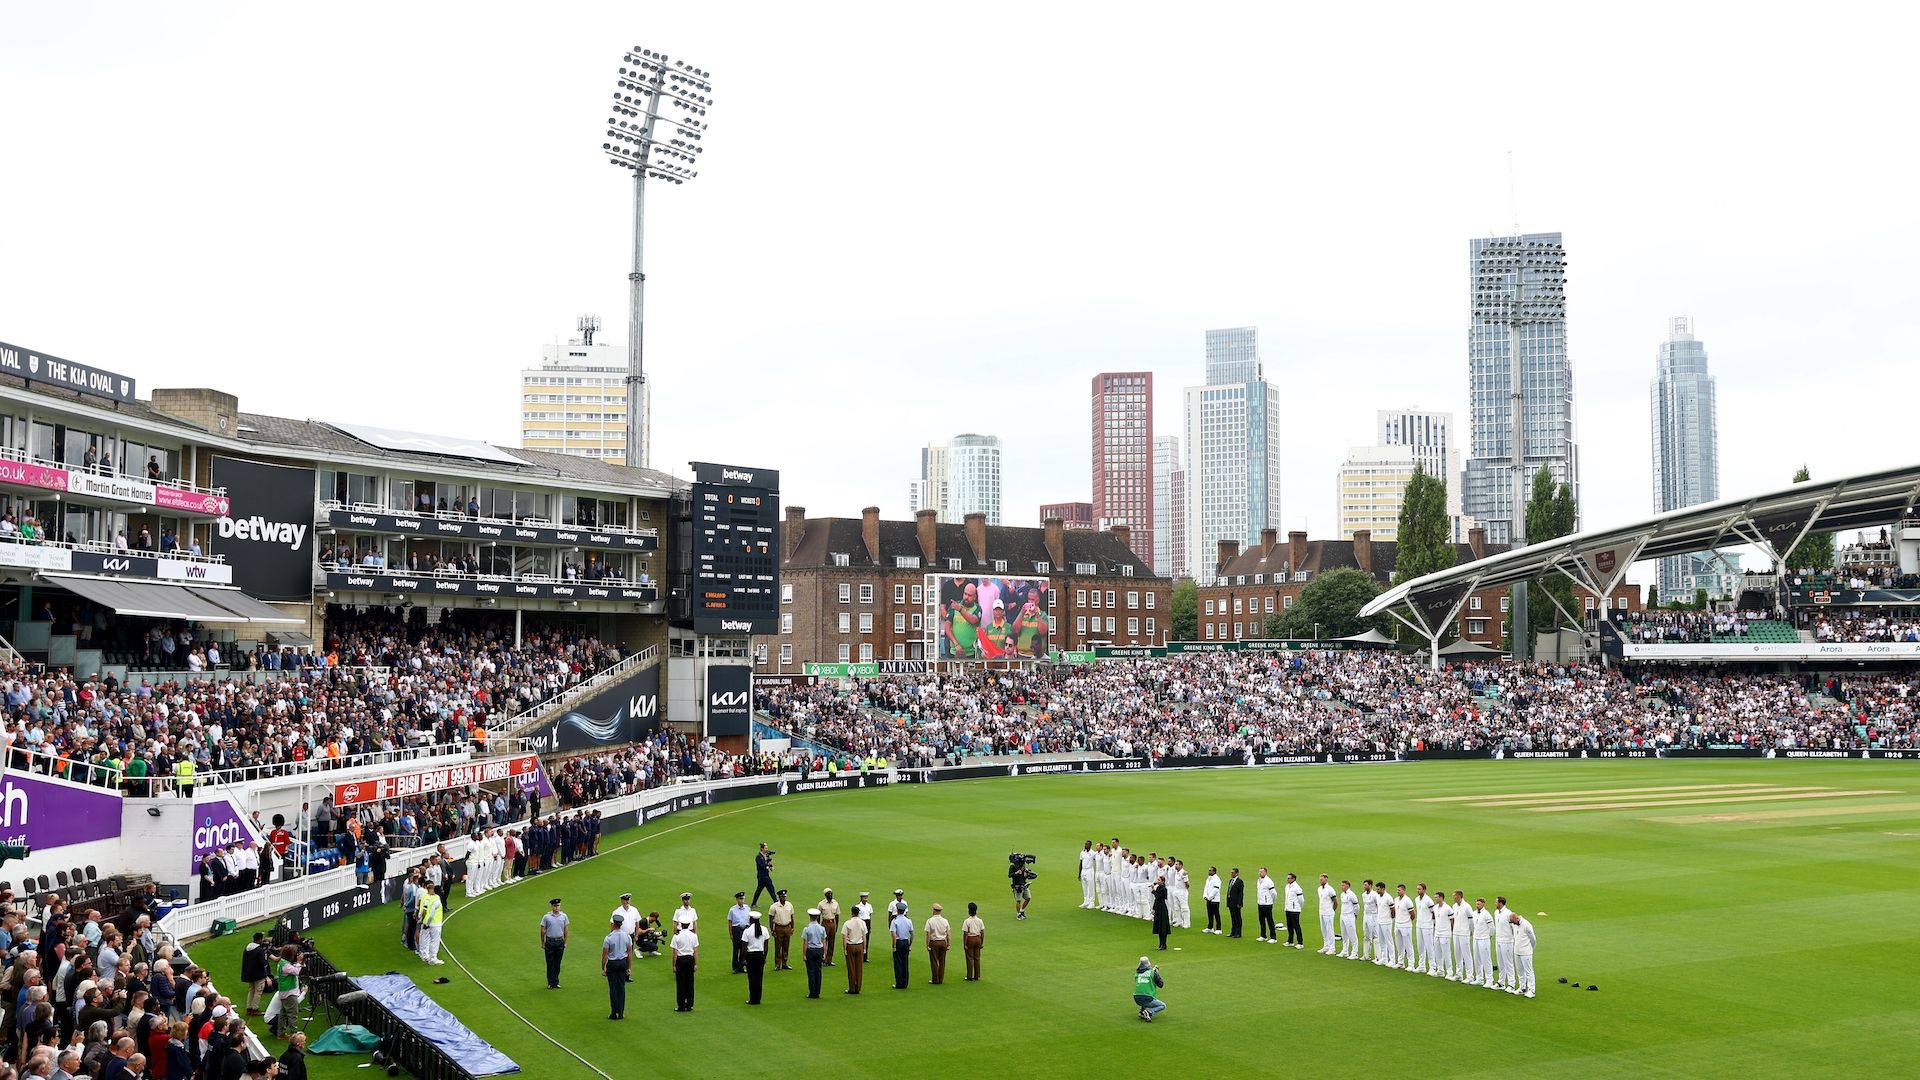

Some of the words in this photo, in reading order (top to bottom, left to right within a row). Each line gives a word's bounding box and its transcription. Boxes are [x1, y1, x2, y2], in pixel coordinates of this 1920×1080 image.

[47, 360, 67, 381] THE
[70, 366, 87, 387] KIA
[90, 372, 114, 394] OVAL
[723, 469, 753, 483] betway
[86, 479, 110, 494] Martin
[111, 484, 130, 497] Grant
[131, 487, 153, 500] Homes
[350, 514, 377, 526] betway
[395, 518, 421, 530] betway
[219, 515, 307, 551] betway
[438, 522, 463, 533] betway
[479, 525, 502, 537] betway
[515, 528, 538, 539] betway
[557, 531, 578, 542] betway
[590, 534, 611, 545] betway
[624, 536, 644, 546] betway
[103, 558, 130, 571] KIA
[185, 565, 206, 578] wtw
[347, 576, 375, 587] betway
[392, 578, 418, 590] betway
[435, 581, 460, 592] betway
[476, 583, 500, 594] betway
[515, 585, 538, 596] betway
[552, 586, 575, 597] betway
[588, 587, 609, 598] betway
[622, 589, 642, 599] betway
[721, 620, 752, 632] betway
[1820, 645, 1843, 653] Arora
[1867, 645, 1890, 653] Arora
[820, 666, 839, 675] XBOX
[857, 666, 875, 675] XBOX
[899, 661, 924, 673] FINN
[712, 691, 747, 705] KIA
[629, 694, 657, 719] KIA
[1026, 766, 1042, 774] QUEEN
[1043, 764, 1067, 772] ELIZABETH
[397, 774, 419, 795] BASH
[421, 770, 448, 791] BOSH
[483, 761, 510, 781] VIRUSES
[796, 783, 814, 791] QUEEN
[815, 780, 840, 790] ELIZABETH
[195, 816, 240, 849] cinch
[322, 901, 339, 918] 1926
[353, 892, 371, 908] 2022
